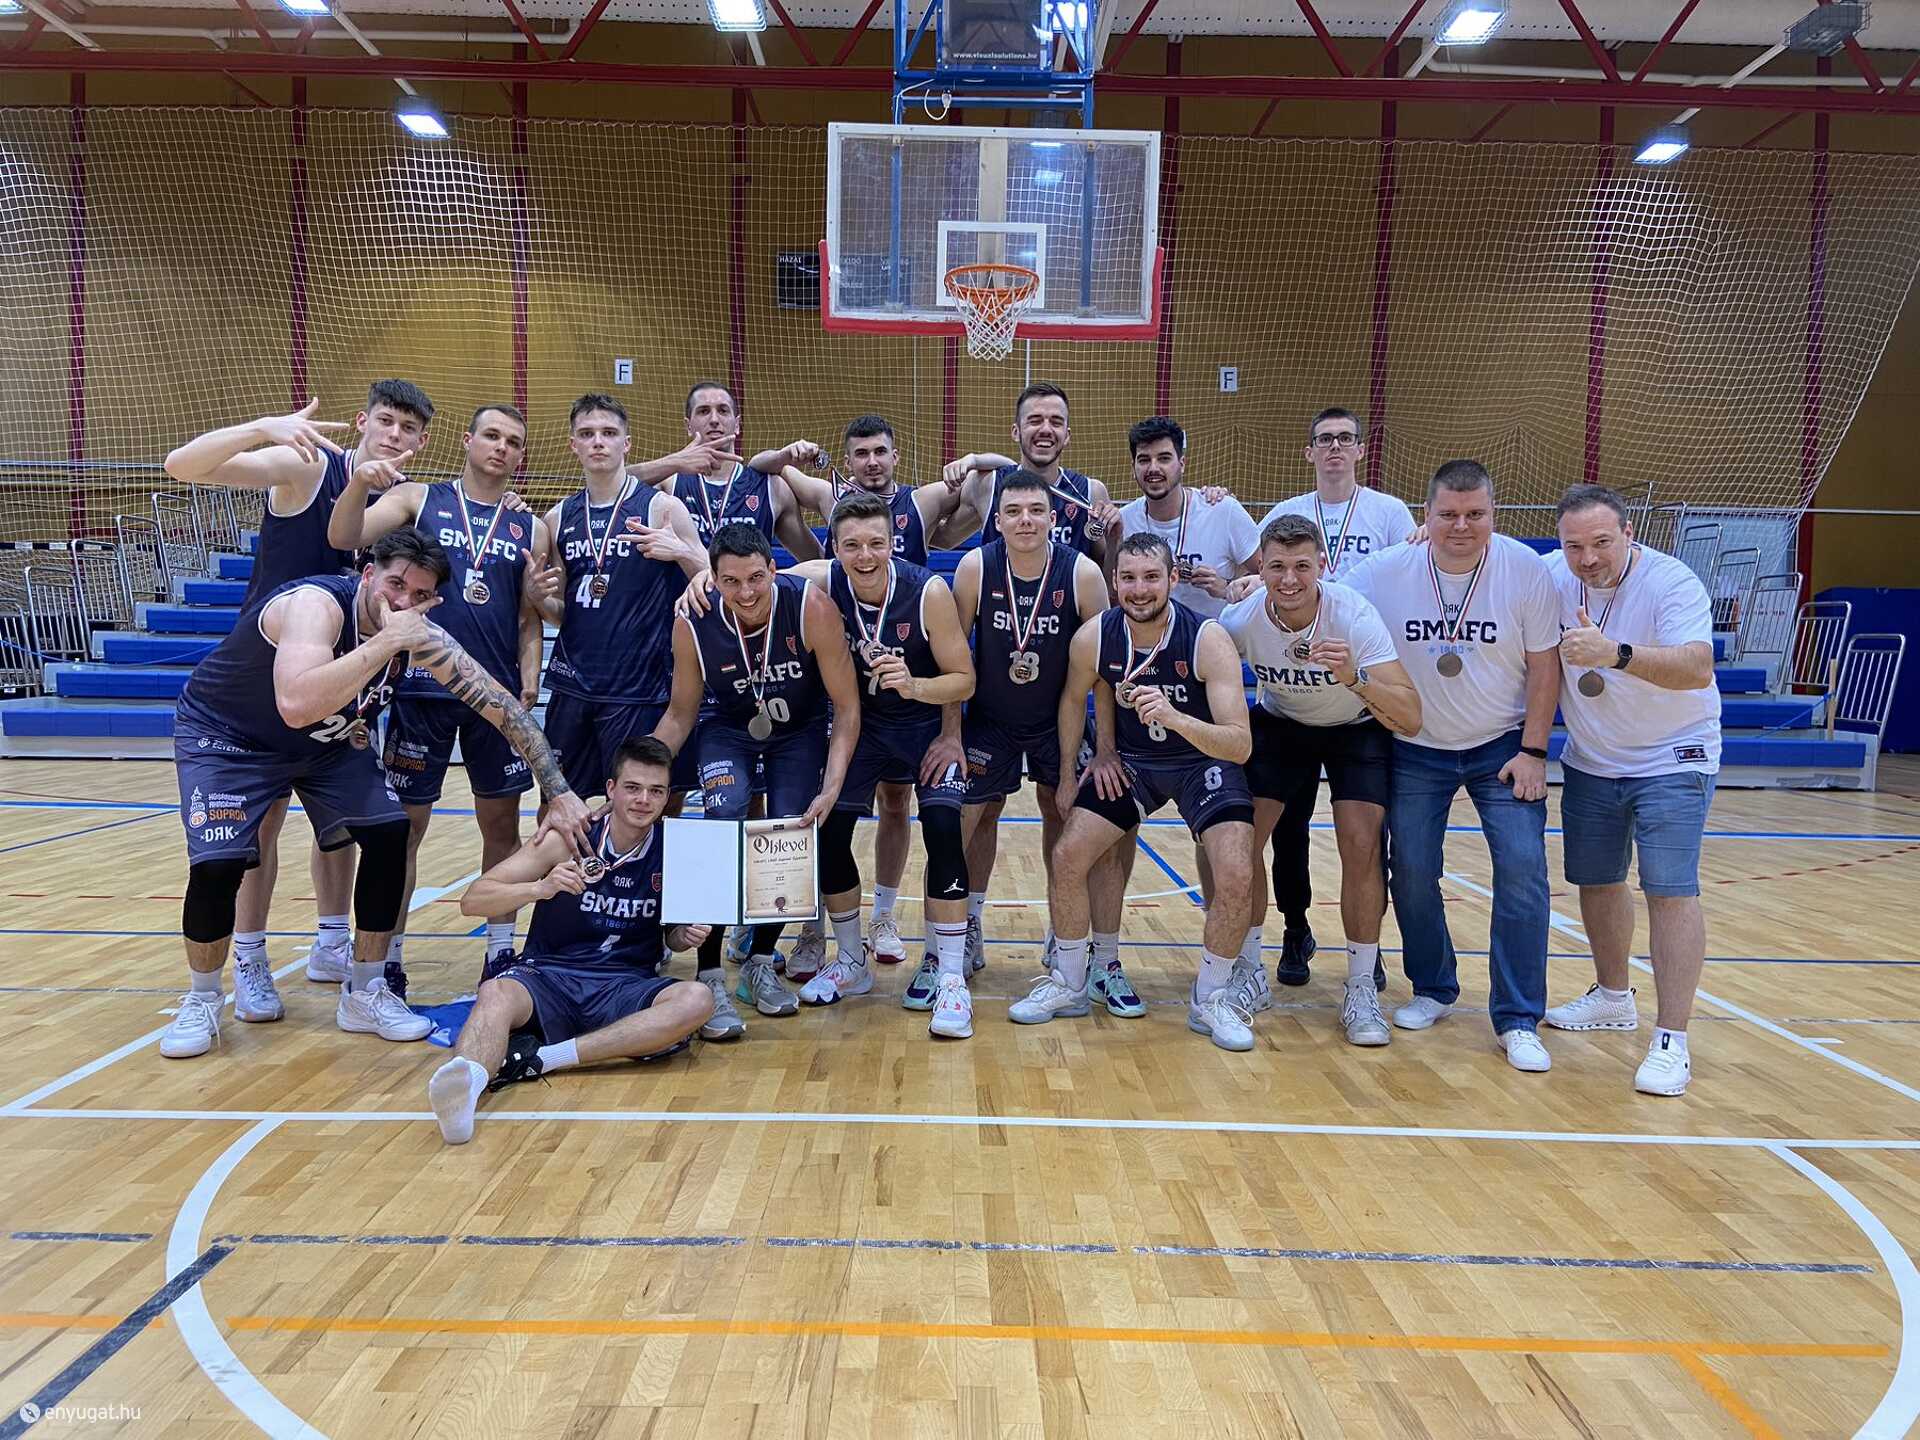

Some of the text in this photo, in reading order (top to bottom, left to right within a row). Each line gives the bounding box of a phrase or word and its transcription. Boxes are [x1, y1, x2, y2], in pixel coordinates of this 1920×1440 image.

[619, 364, 629, 381] F
[1224, 371, 1234, 389] F
[565, 539, 630, 560] SMFC
[1328, 535, 1370, 554] AFC
[1255, 664, 1341, 686] SMAFC
[757, 698, 790, 722] 10
[580, 891, 656, 917] SMAFC
